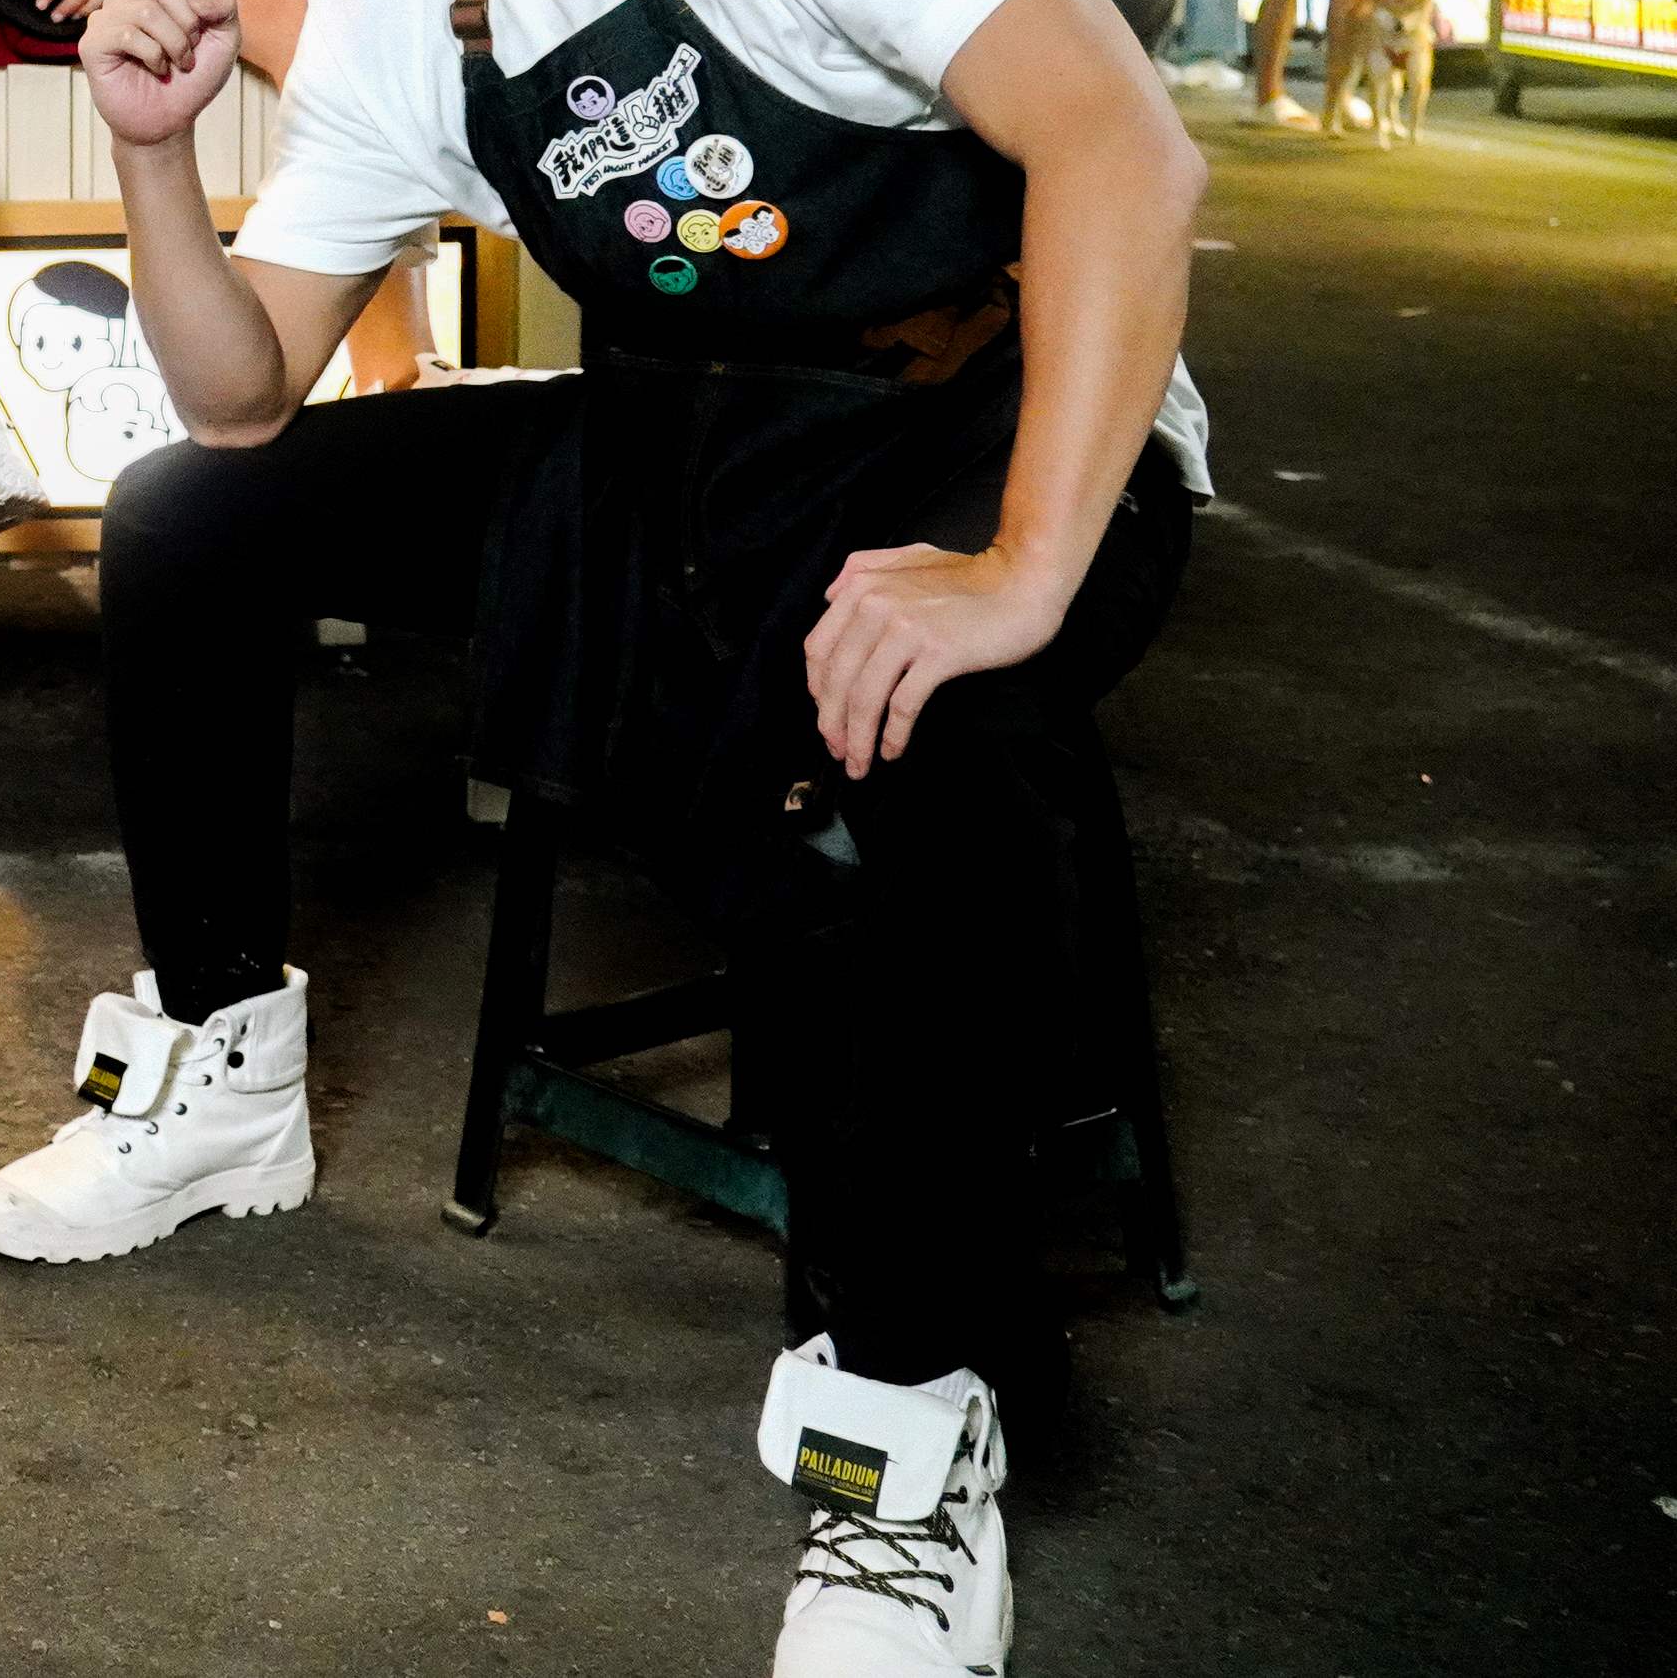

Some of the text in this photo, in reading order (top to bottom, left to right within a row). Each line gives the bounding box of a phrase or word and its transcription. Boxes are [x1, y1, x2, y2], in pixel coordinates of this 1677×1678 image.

[603, 162, 635, 174] NIGHT
[638, 138, 674, 168] MARKET
[798, 1446, 880, 1489] PALLADIUM
